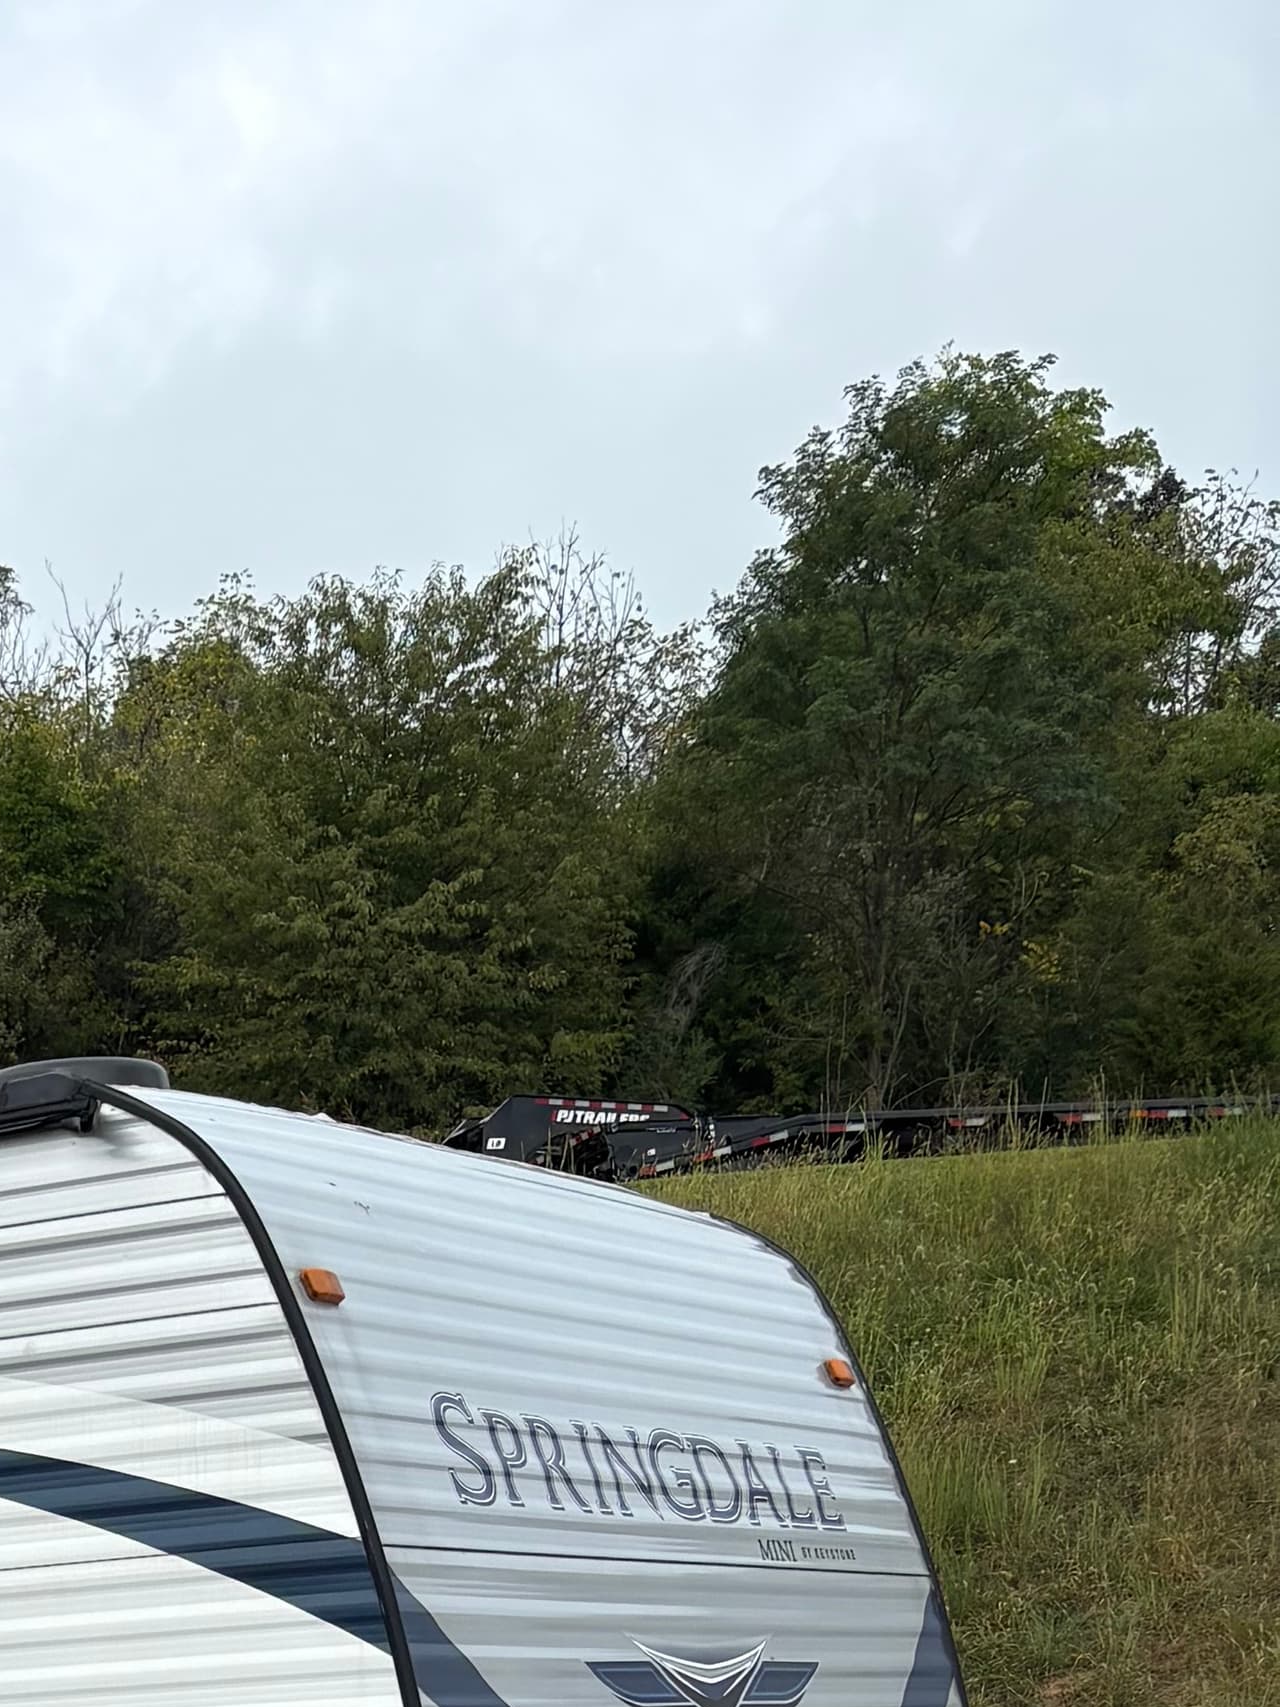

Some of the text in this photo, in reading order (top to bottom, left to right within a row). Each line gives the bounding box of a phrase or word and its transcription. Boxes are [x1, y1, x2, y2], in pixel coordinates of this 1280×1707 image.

[430, 1391, 848, 1532] SPRINGDALE
[758, 1539, 797, 1562] MINI
[801, 1546, 811, 1559] BY
